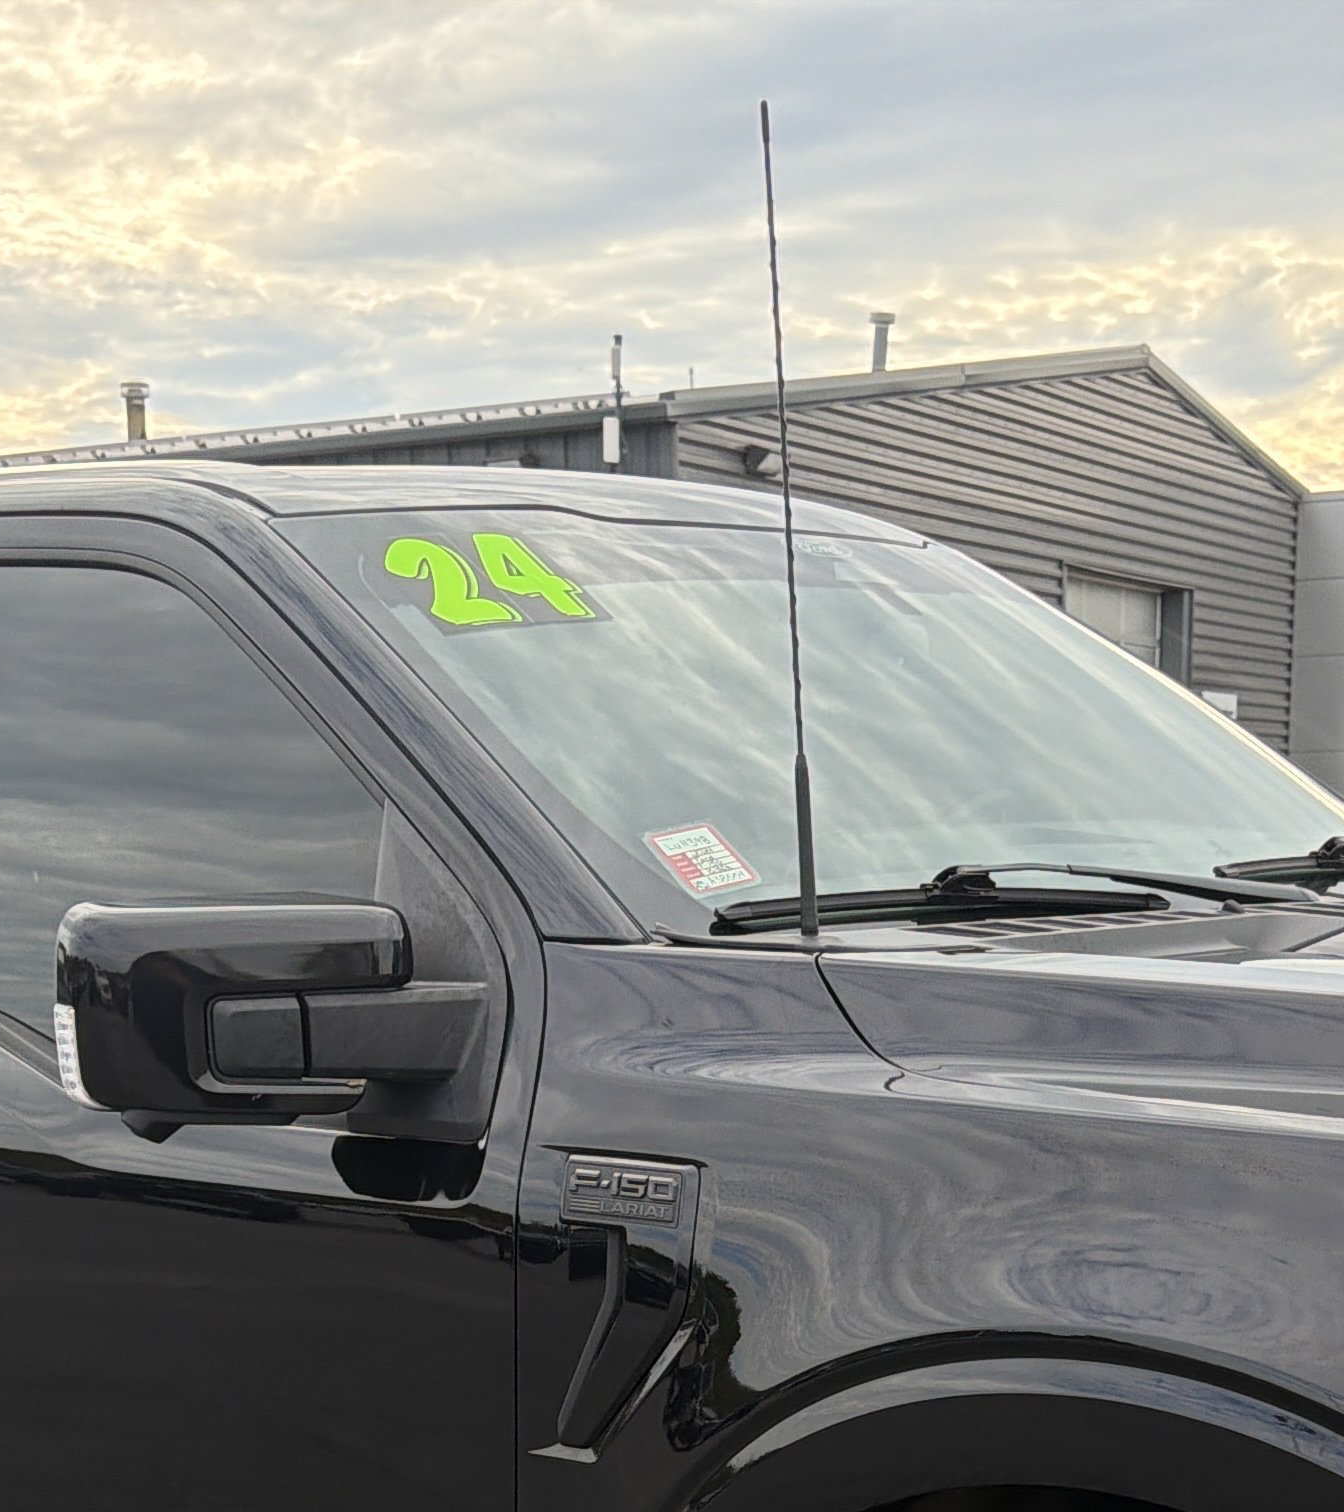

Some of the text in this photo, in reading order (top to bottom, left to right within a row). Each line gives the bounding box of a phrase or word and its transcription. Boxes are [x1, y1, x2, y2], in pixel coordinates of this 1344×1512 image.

[385, 533, 596, 624] 24
[569, 1168, 678, 1202] F-150
[599, 1200, 670, 1220] LARIAT
